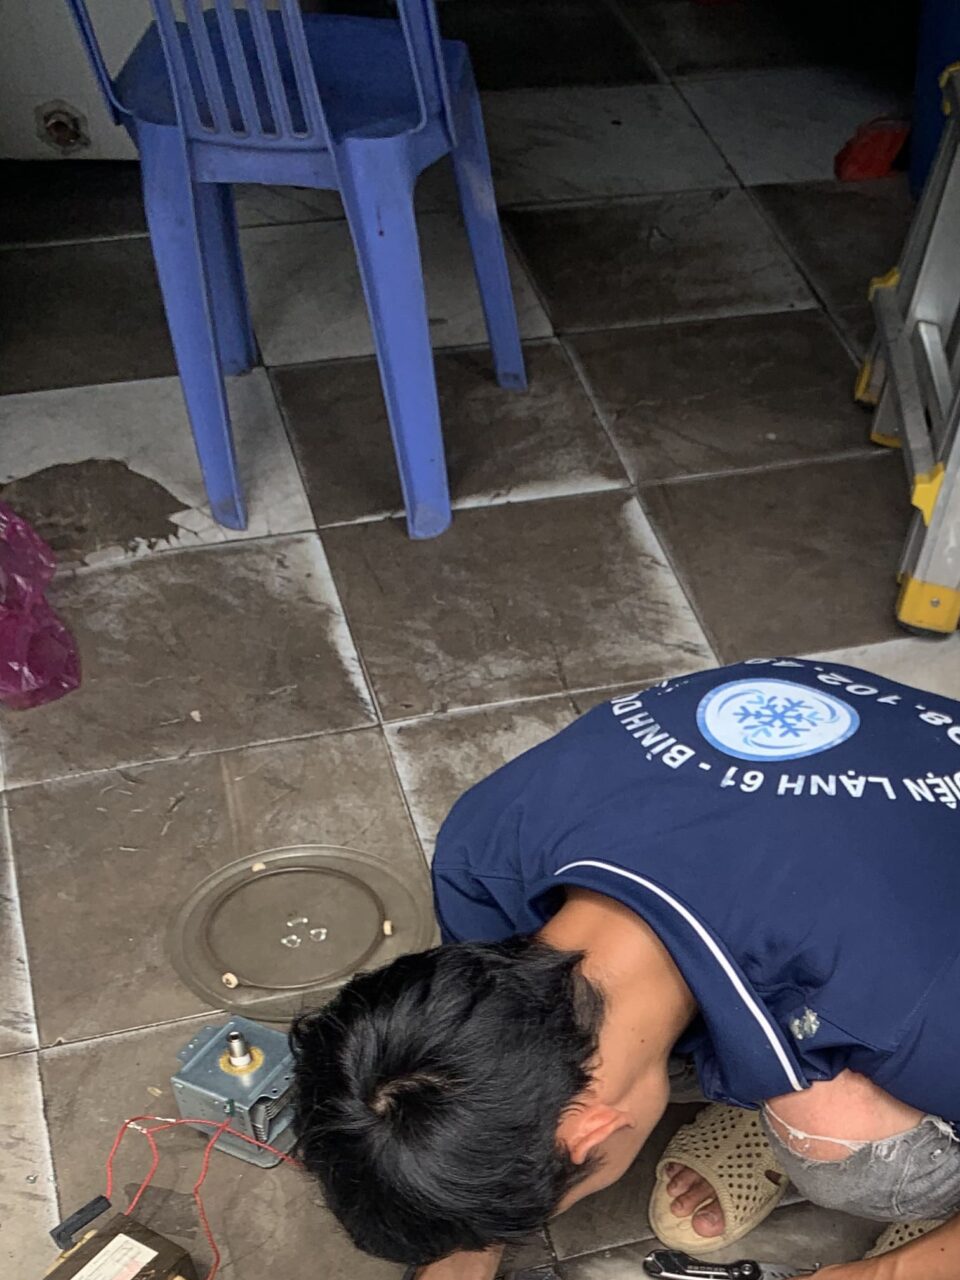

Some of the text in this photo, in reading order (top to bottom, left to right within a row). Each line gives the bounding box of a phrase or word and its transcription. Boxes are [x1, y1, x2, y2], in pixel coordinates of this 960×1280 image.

[620, 711, 696, 770] BÌNH
[720, 766, 765, 793] 61
[777, 769, 896, 800] LẠNH
